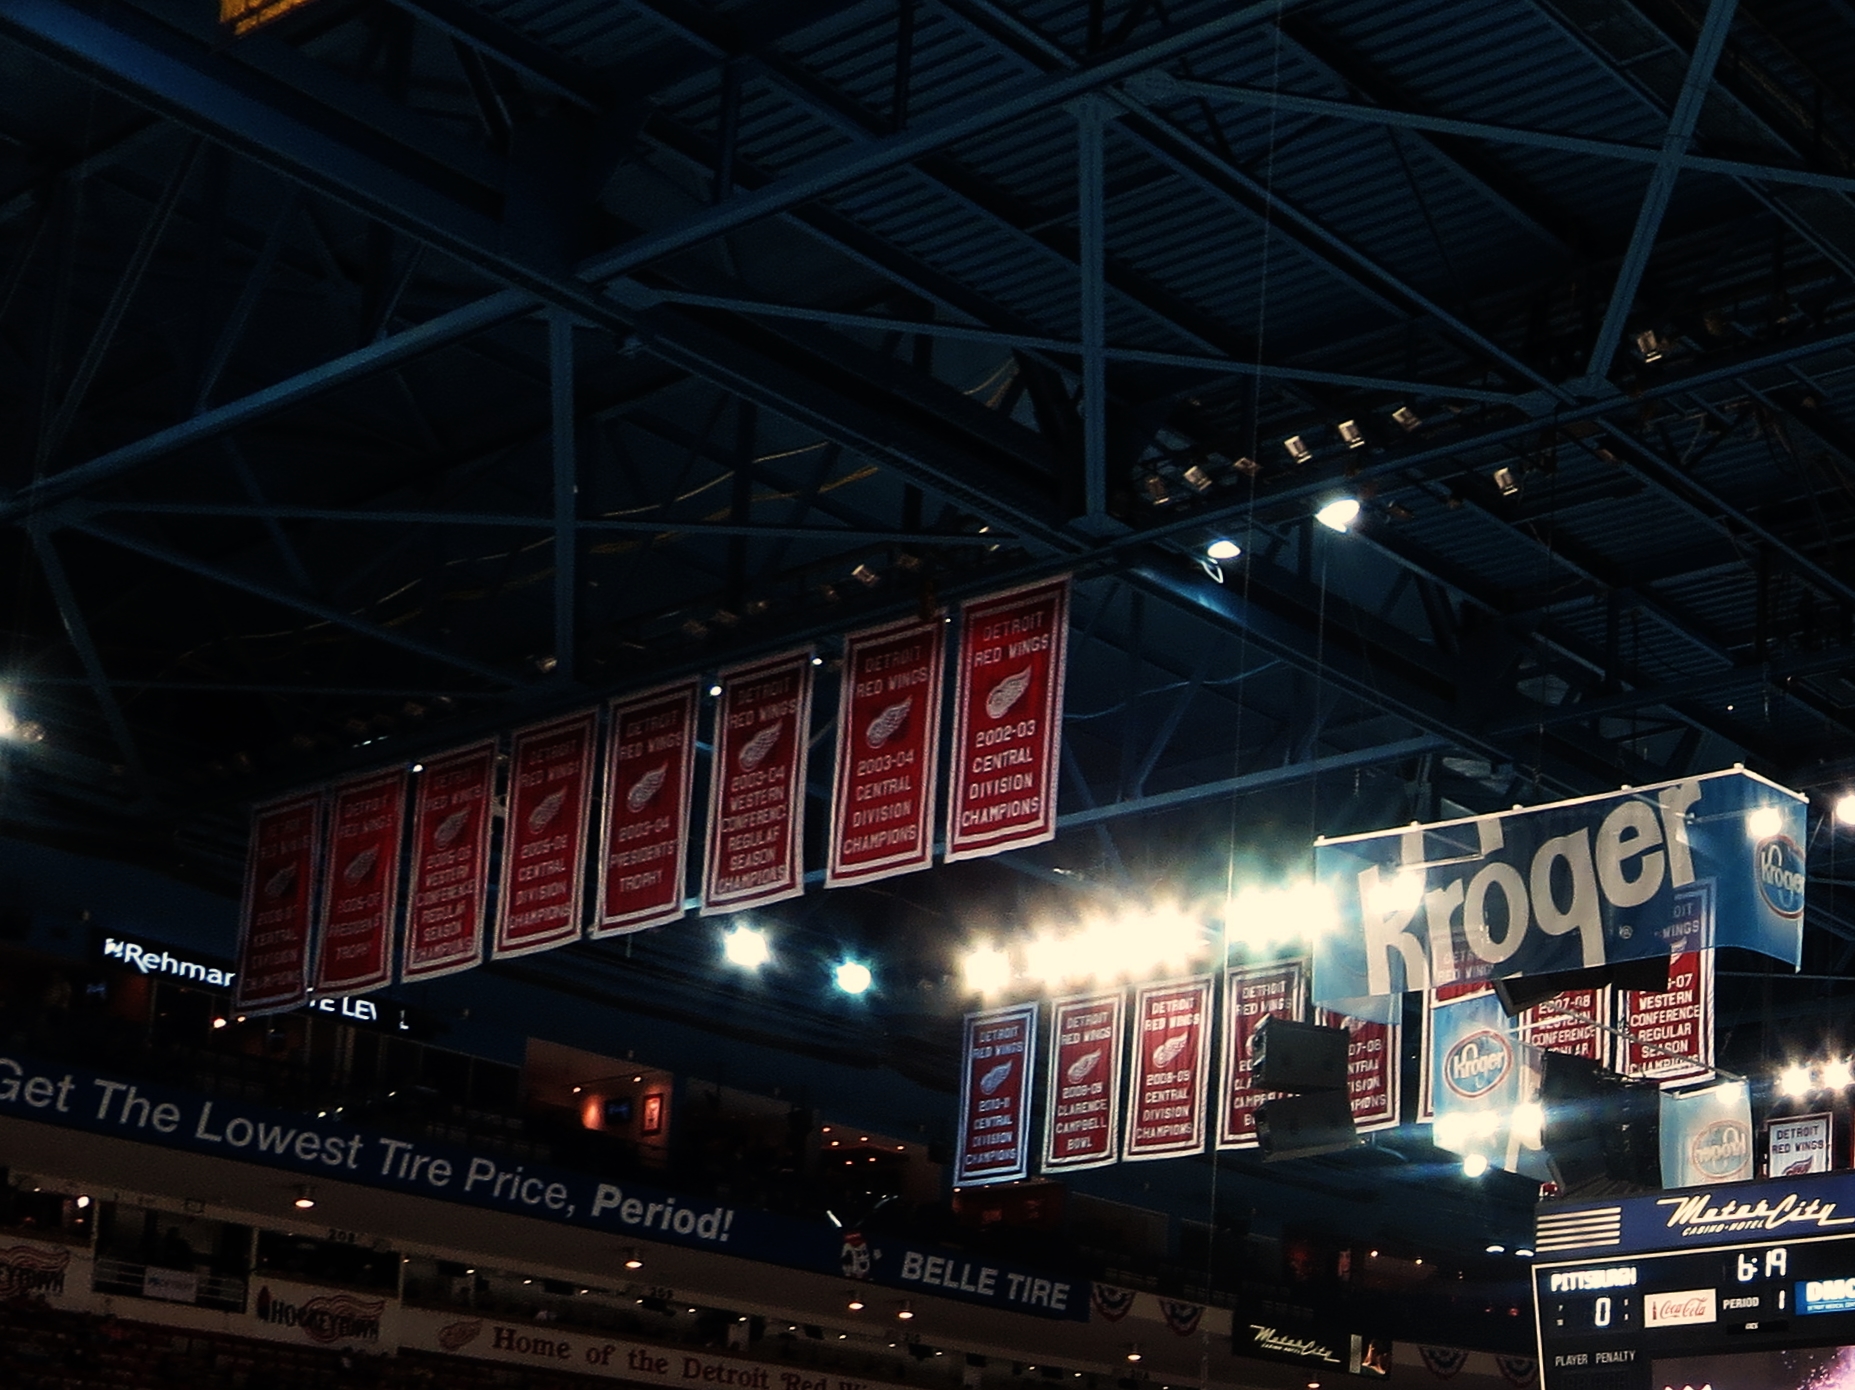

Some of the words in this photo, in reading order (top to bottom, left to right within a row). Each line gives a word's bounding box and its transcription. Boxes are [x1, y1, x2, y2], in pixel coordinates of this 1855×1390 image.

[983, 611, 1043, 642] DETROIT
[974, 649, 1001, 668] RED
[1009, 634, 1049, 657] WINGS
[976, 720, 1036, 747] 2002-03
[857, 750, 914, 777] 2003-04
[972, 748, 1032, 773] CENTRAL
[969, 772, 1032, 800] DIVISION
[962, 797, 1039, 827] CHAMPIONS
[1358, 778, 1702, 995] Kroger
[1639, 990, 1693, 1009] WESTERN
[1630, 1005, 1701, 1027] CONFERENCE
[1637, 1022, 1691, 1042] REGULAR
[1640, 1039, 1688, 1058] SEASON
[1452, 1042, 1506, 1087] Kroger
[1056, 1099, 1107, 1117] CLARENCE
[0, 1059, 75, 1113] Get
[94, 1078, 181, 1133] The
[195, 1100, 365, 1171] Lowest
[378, 1136, 453, 1186] Tire
[464, 1157, 577, 1218] Price,
[1056, 1118, 1107, 1134] CAMPBELL
[1066, 1136, 1092, 1150] BOWL
[591, 1183, 735, 1242] Period!
[1738, 1249, 1787, 1281] 6:19
[901, 1250, 998, 1298] BELLE
[1006, 1272, 1071, 1311] TIRE
[1551, 1267, 1637, 1291] PITTSBURGH
[1594, 1297, 1611, 1327] 0
[1722, 1297, 1759, 1310] PERIOD
[490, 1325, 572, 1360] Home
[585, 1343, 614, 1367] of
[628, 1349, 669, 1375] the
[681, 1358, 770, 1390] Detroit
[1555, 1352, 1588, 1366] PLAYER
[1595, 1350, 1635, 1364] PENALTY
